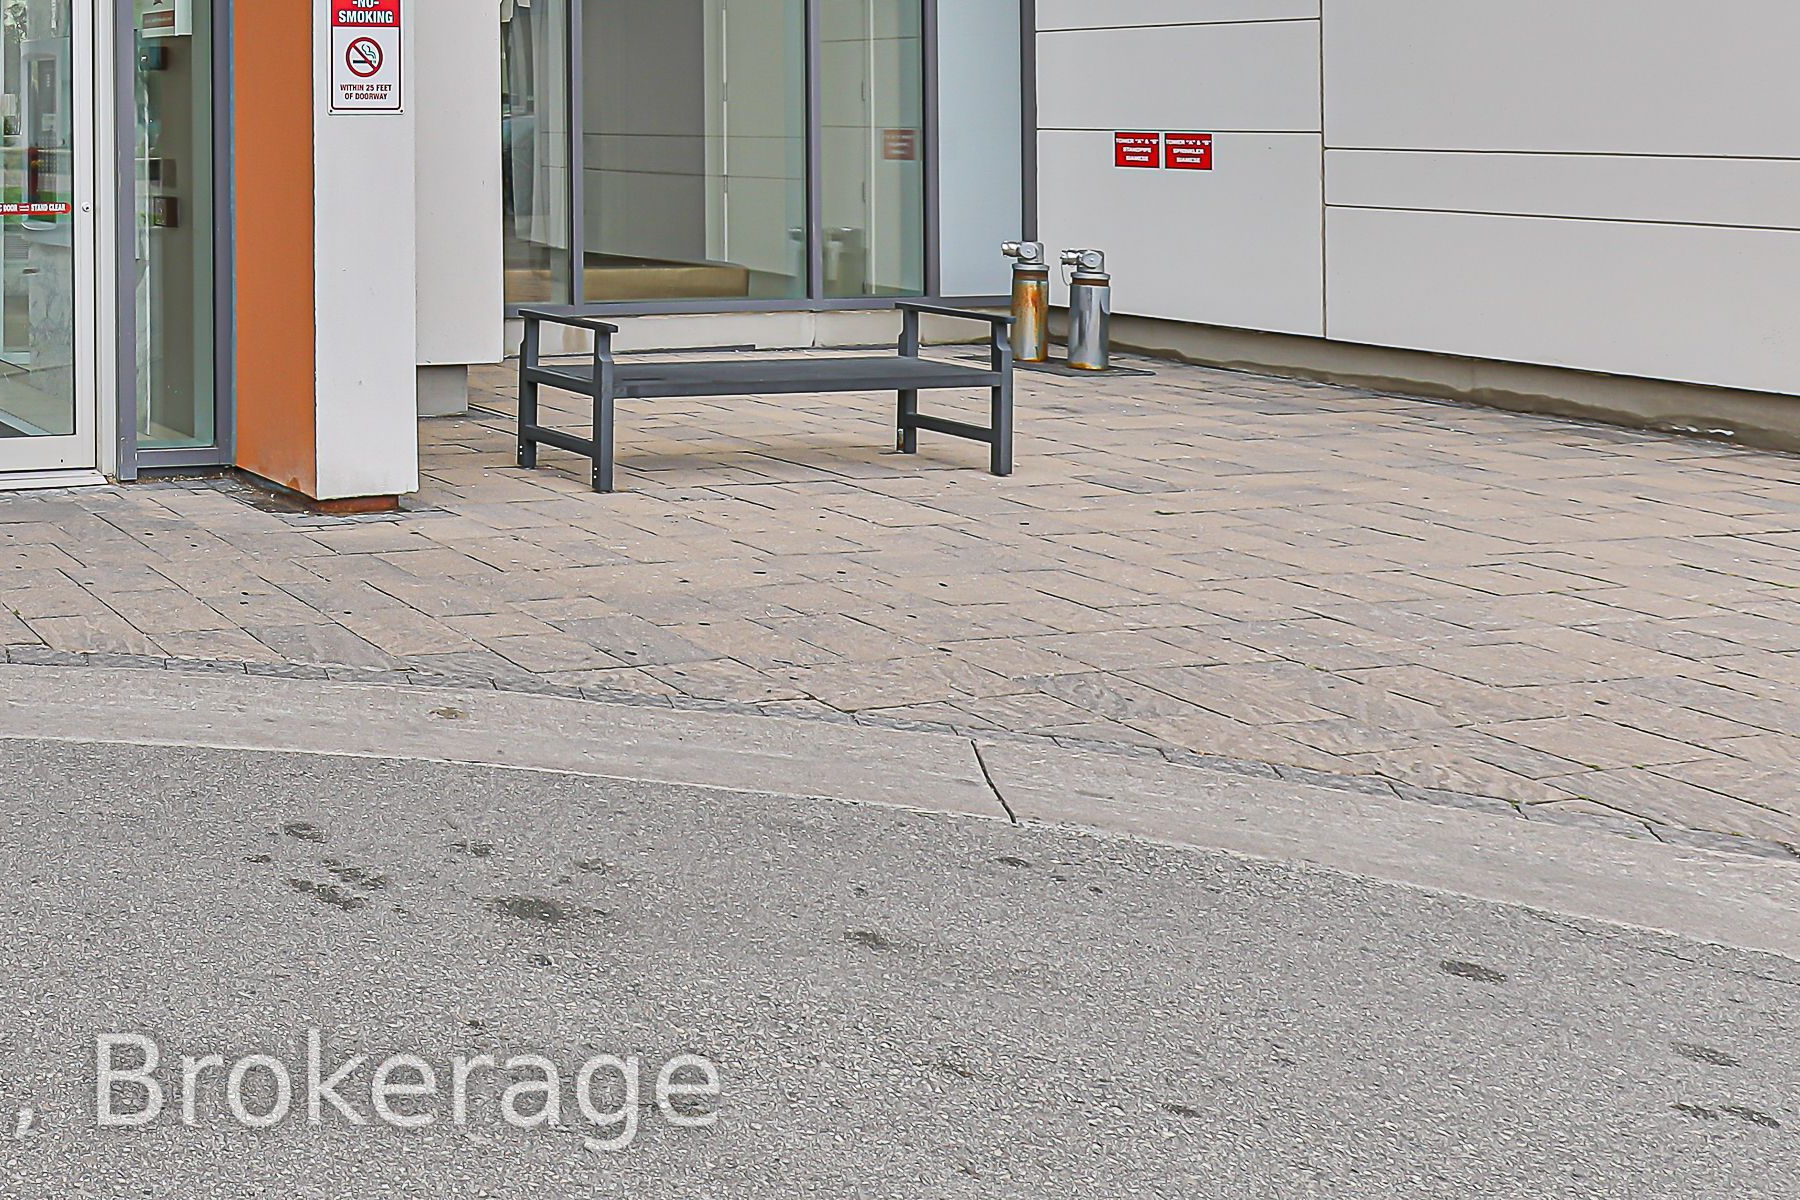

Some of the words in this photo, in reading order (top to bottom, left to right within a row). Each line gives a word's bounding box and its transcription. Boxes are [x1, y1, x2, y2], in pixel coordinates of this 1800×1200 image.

[338, 10, 394, 23] SMOKING
[340, 84, 364, 92] WITHIN
[365, 84, 375, 92] 25
[376, 84, 392, 92] FEET
[344, 92, 354, 100] OF
[355, 92, 388, 100] DOORWAY
[3, 204, 18, 212] DOOR
[30, 203, 48, 212] STAND
[49, 203, 66, 211] CLEAR
